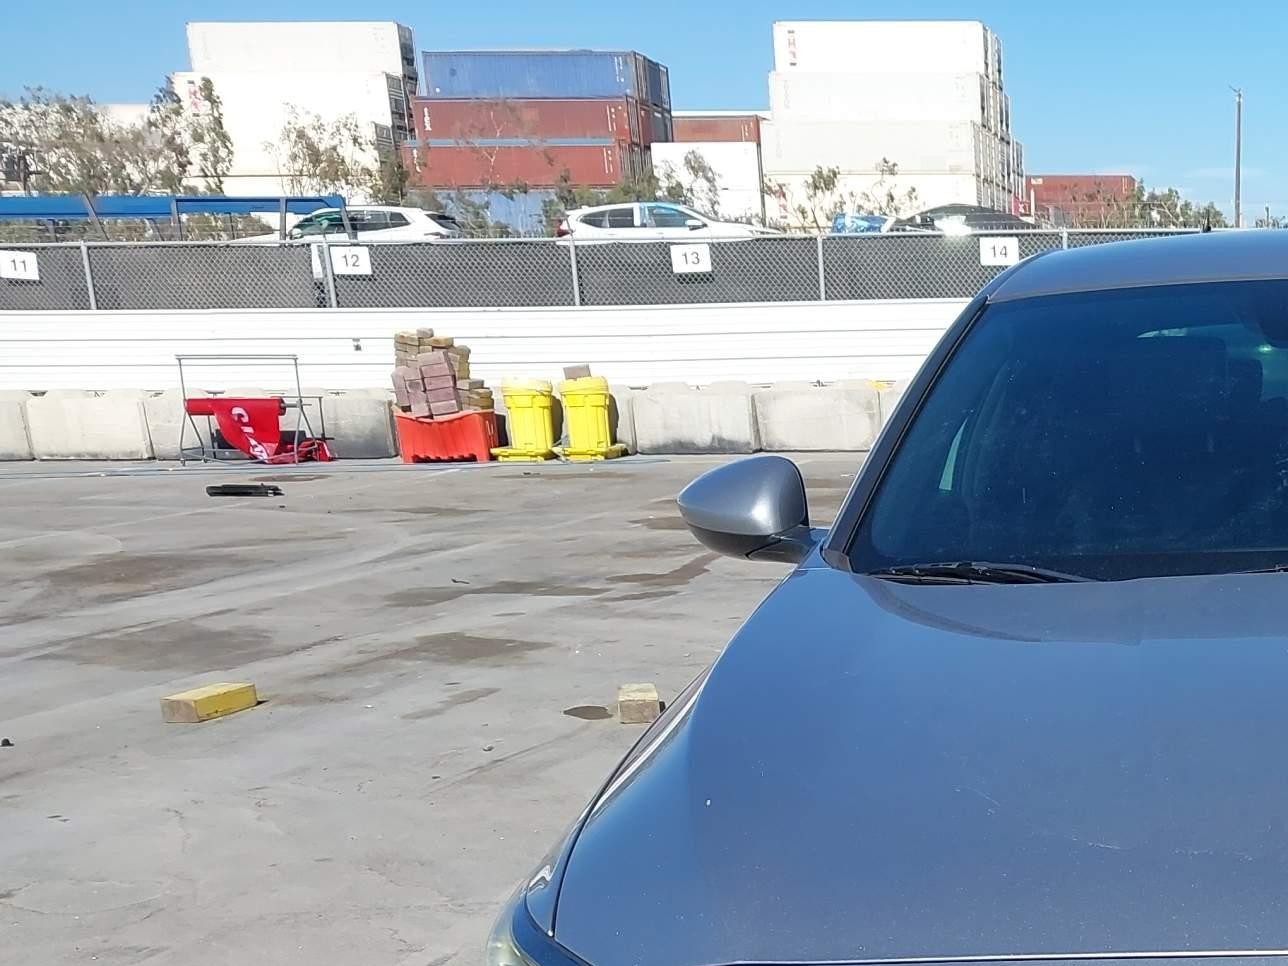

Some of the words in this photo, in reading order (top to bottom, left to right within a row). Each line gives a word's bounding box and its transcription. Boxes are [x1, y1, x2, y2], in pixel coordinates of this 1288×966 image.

[682, 251, 700, 265] 13
[991, 245, 1008, 258] 14
[10, 258, 27, 272] 11
[342, 254, 360, 267] 12
